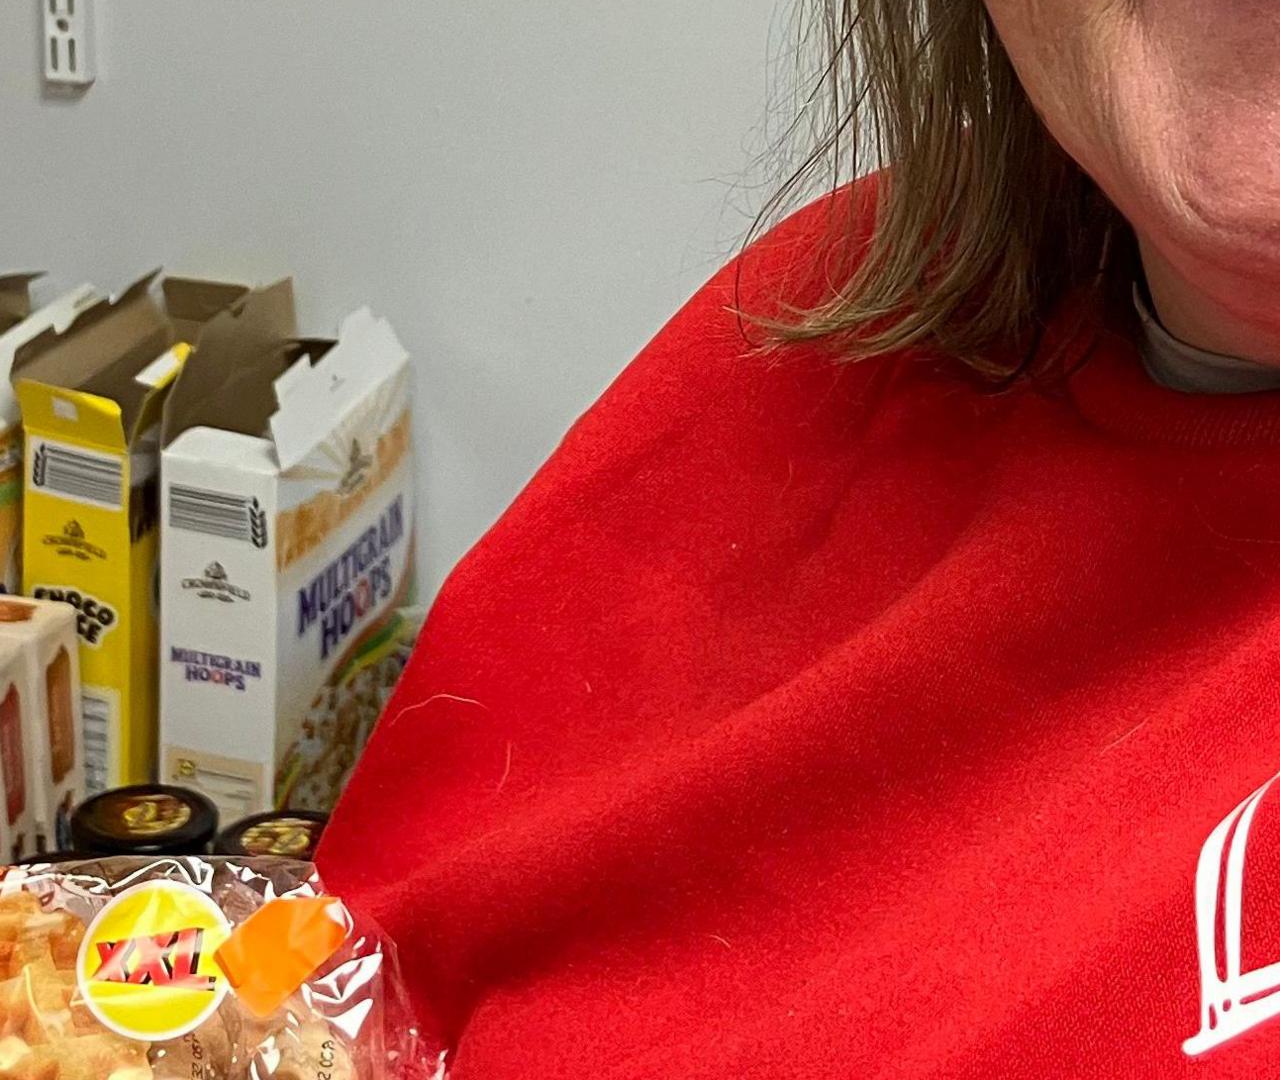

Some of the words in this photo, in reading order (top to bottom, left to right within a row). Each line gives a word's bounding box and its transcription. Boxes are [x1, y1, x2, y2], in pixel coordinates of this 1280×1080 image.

[297, 492, 404, 637] MULTIGRAIN
[320, 555, 393, 660] HOOPS
[170, 645, 262, 679] MULTIGRAIN
[185, 665, 246, 691] HOOPS
[91, 927, 217, 992] XXL
